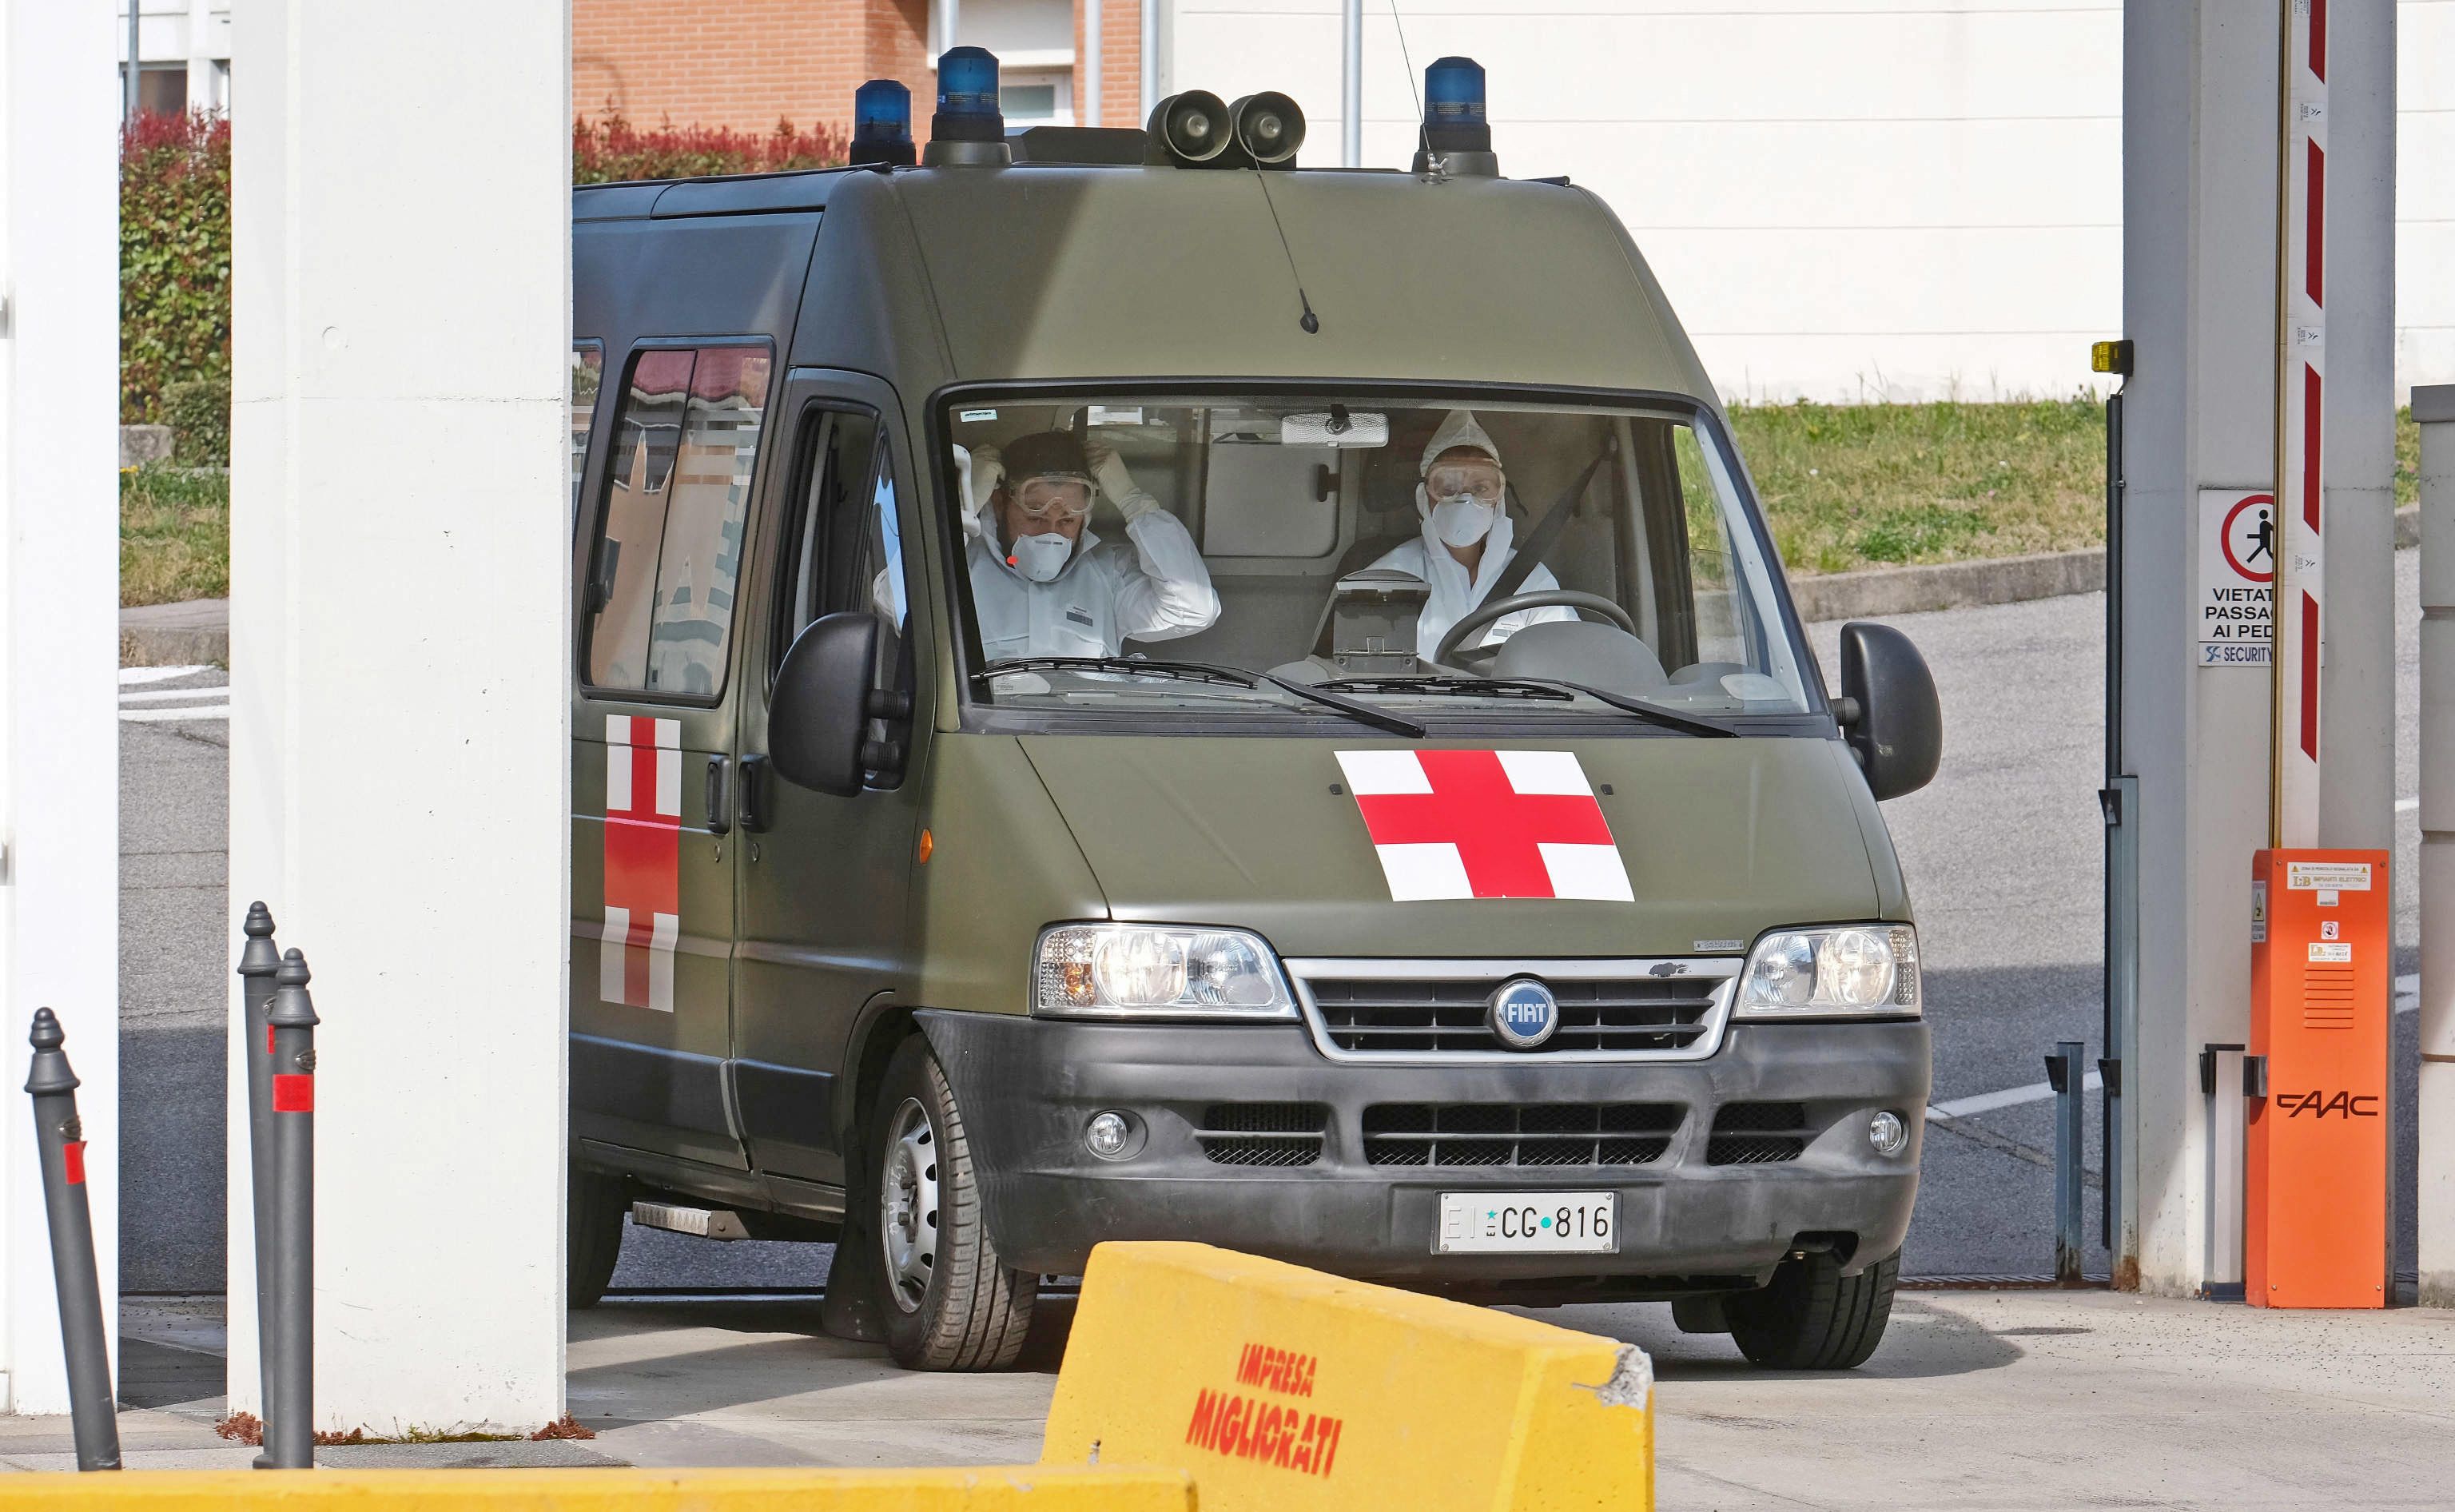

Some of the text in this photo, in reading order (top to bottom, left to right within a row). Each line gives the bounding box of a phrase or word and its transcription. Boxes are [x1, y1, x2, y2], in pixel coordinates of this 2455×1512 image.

[2205, 606, 2273, 620] PASSA
[2212, 624, 2230, 638] AI
[1508, 1003, 1547, 1023] FIAT
[1502, 1205, 1609, 1239] CG 816
[1235, 1343, 1317, 1398] IMPRESA
[1185, 1387, 1343, 1479] MIGLIORATI
